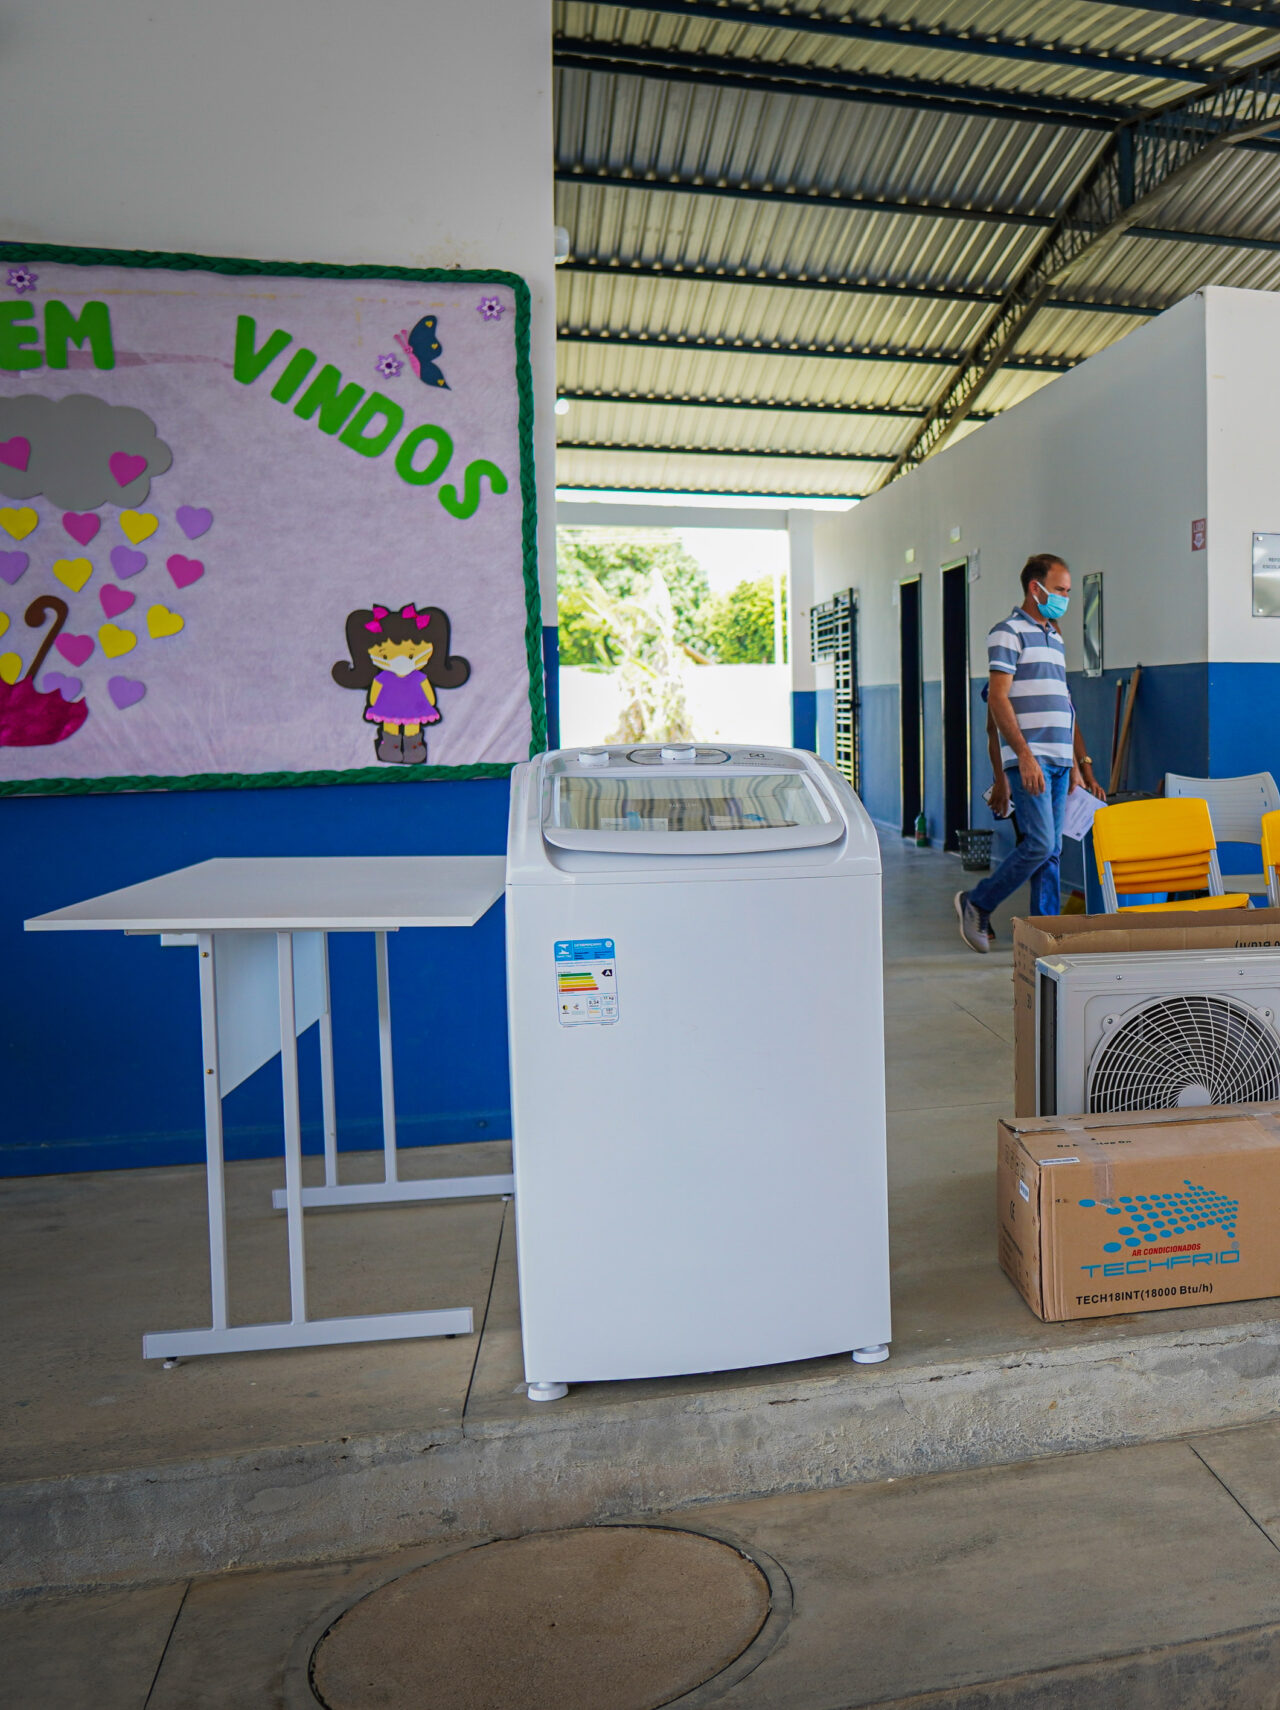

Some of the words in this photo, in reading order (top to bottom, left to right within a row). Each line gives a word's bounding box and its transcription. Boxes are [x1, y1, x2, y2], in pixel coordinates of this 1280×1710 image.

[233, 314, 509, 521] VINDOS
[1143, 1243, 1201, 1256] CONDICIONADOS
[1080, 1250, 1240, 1278] TECHFRIO
[1076, 1286, 1177, 1305] TECH18INT(18000
[1180, 1283, 1213, 1295] Btu/h)
